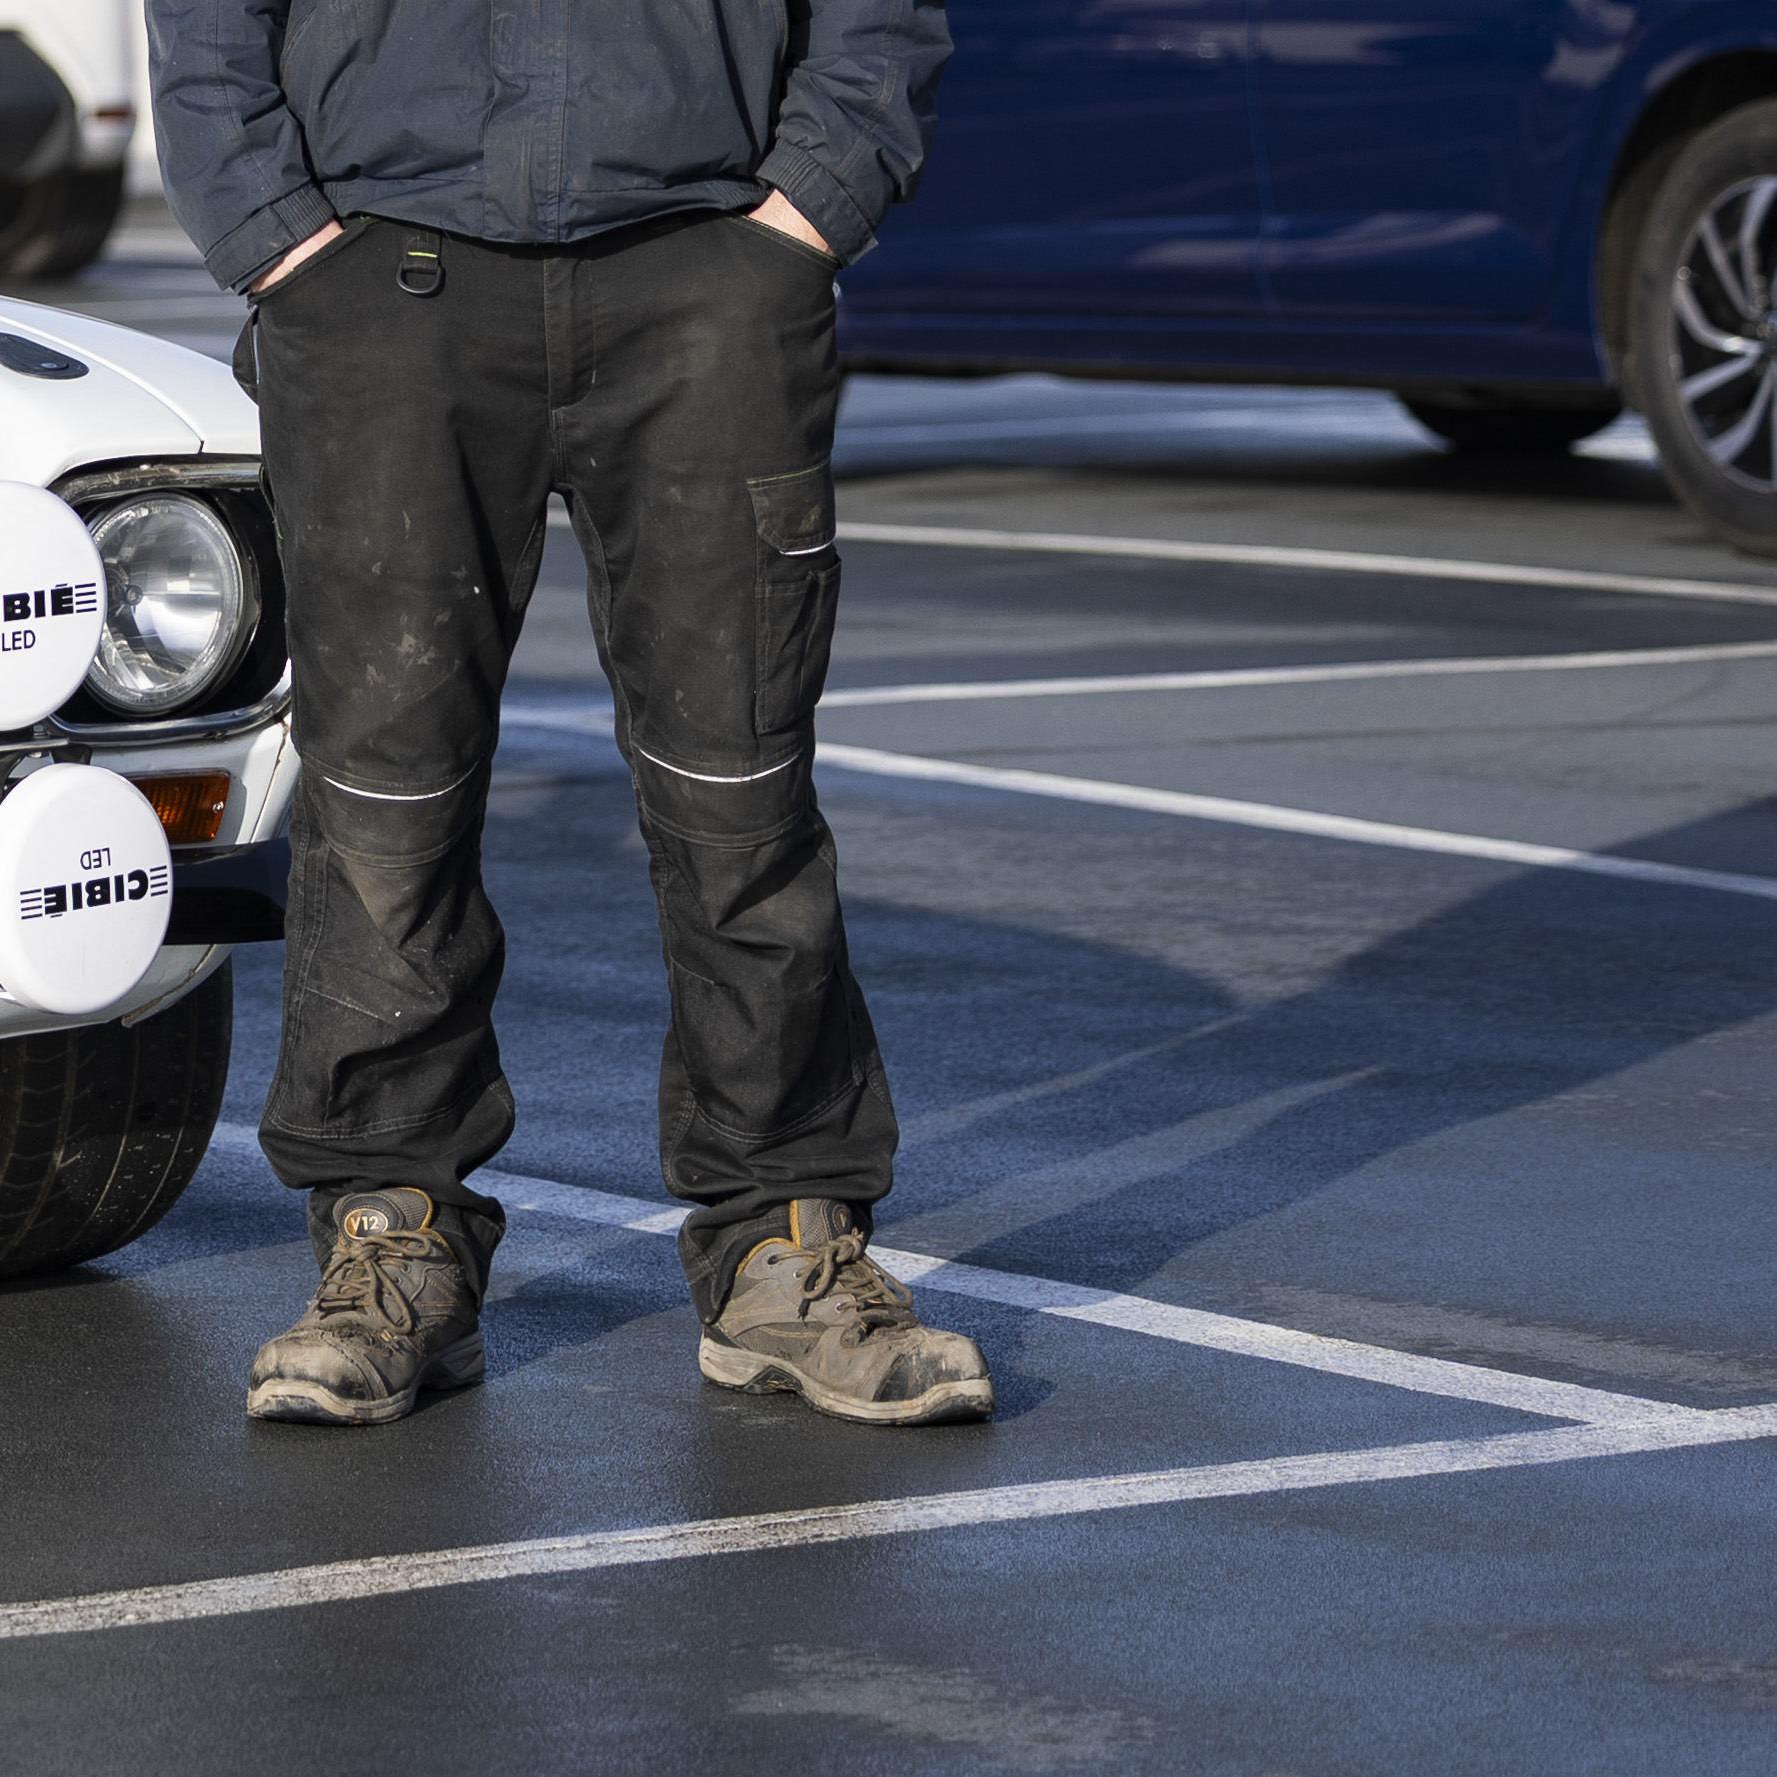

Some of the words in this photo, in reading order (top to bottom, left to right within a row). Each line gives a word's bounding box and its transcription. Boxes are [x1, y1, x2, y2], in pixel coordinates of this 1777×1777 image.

[1, 630, 36, 652] LED
[80, 847, 111, 870] LED
[350, 1216, 380, 1231] V12
